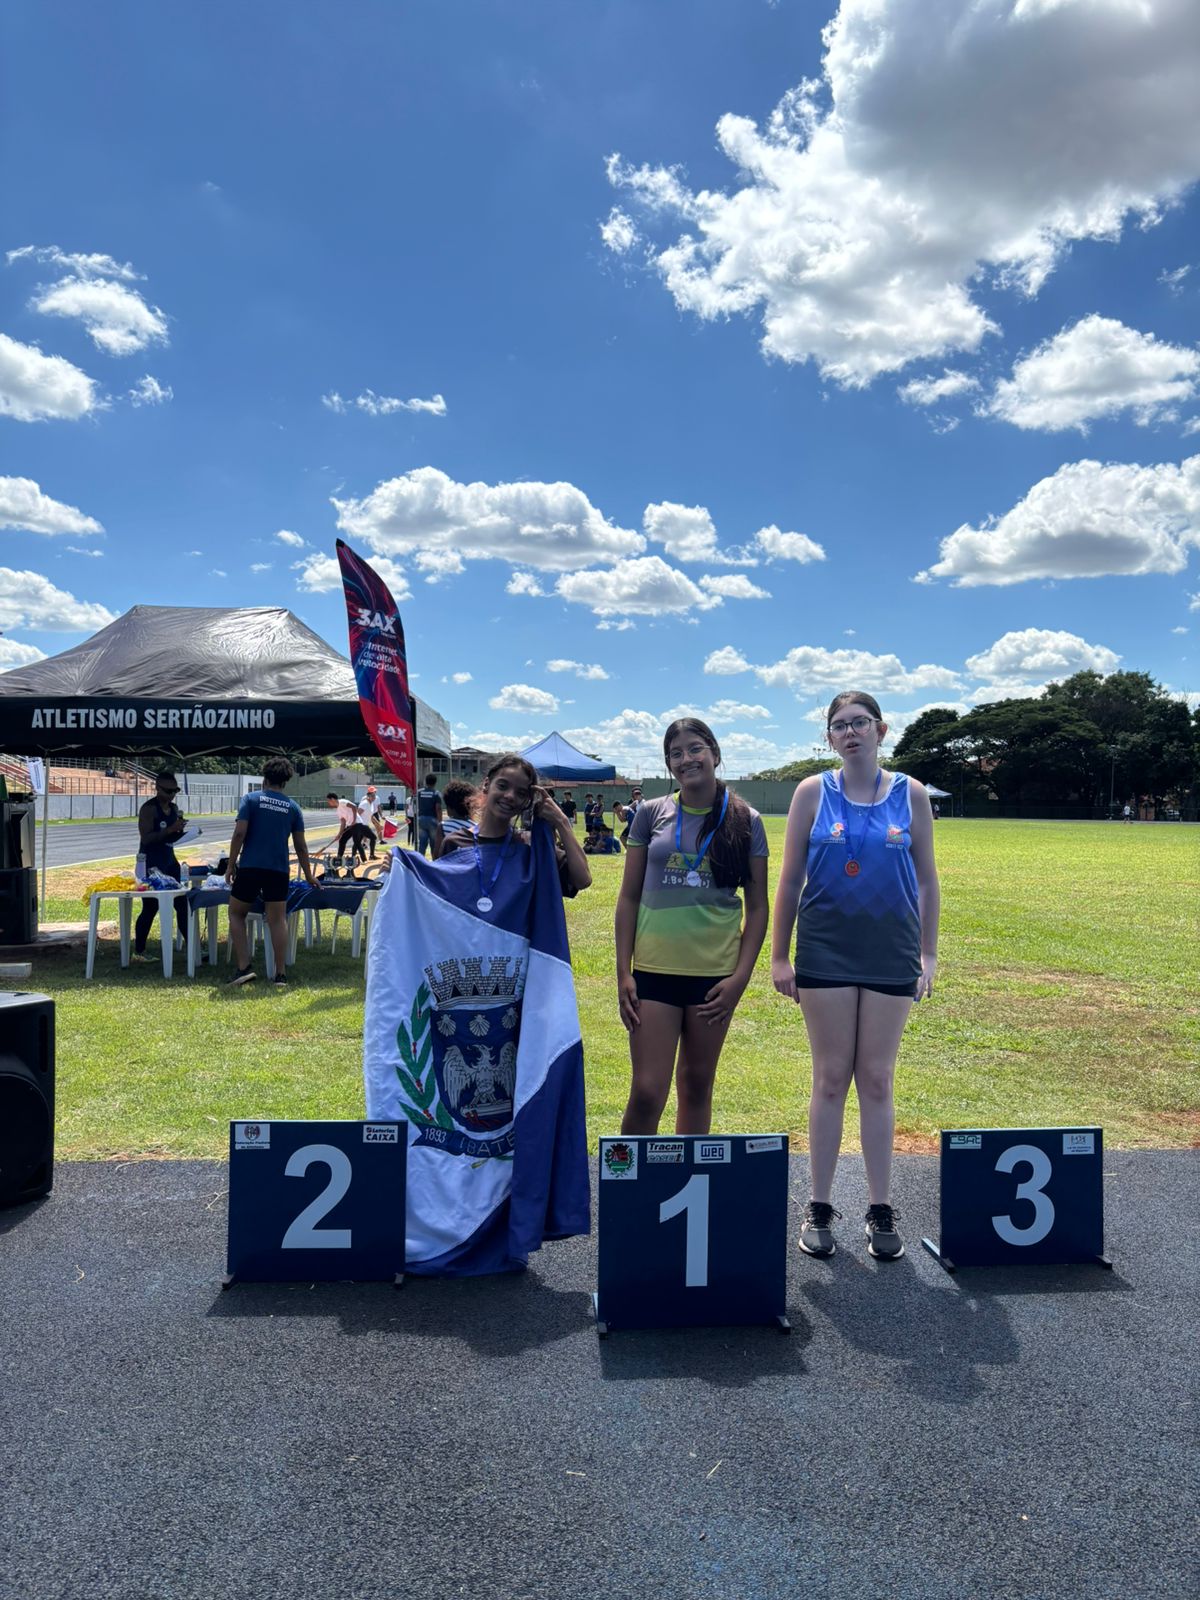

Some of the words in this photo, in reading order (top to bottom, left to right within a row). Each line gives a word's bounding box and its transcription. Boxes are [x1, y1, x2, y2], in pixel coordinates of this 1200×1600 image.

[355, 608, 397, 634] 3AX
[363, 650, 376, 660] de
[377, 653, 392, 664] alta
[368, 642, 398, 657] Internet
[31, 708, 138, 729] ATLETISMO
[143, 704, 276, 729] SERTÃOZINHO
[377, 722, 407, 741] 3AX
[259, 795, 291, 808] INSTITUTO
[366, 1133, 396, 1141] CAIXA
[424, 1127, 447, 1144] 1893
[648, 1141, 684, 1151] Tracan
[281, 1144, 352, 1249] 2
[991, 1144, 1056, 1247] 3
[659, 1174, 710, 1287] 1
